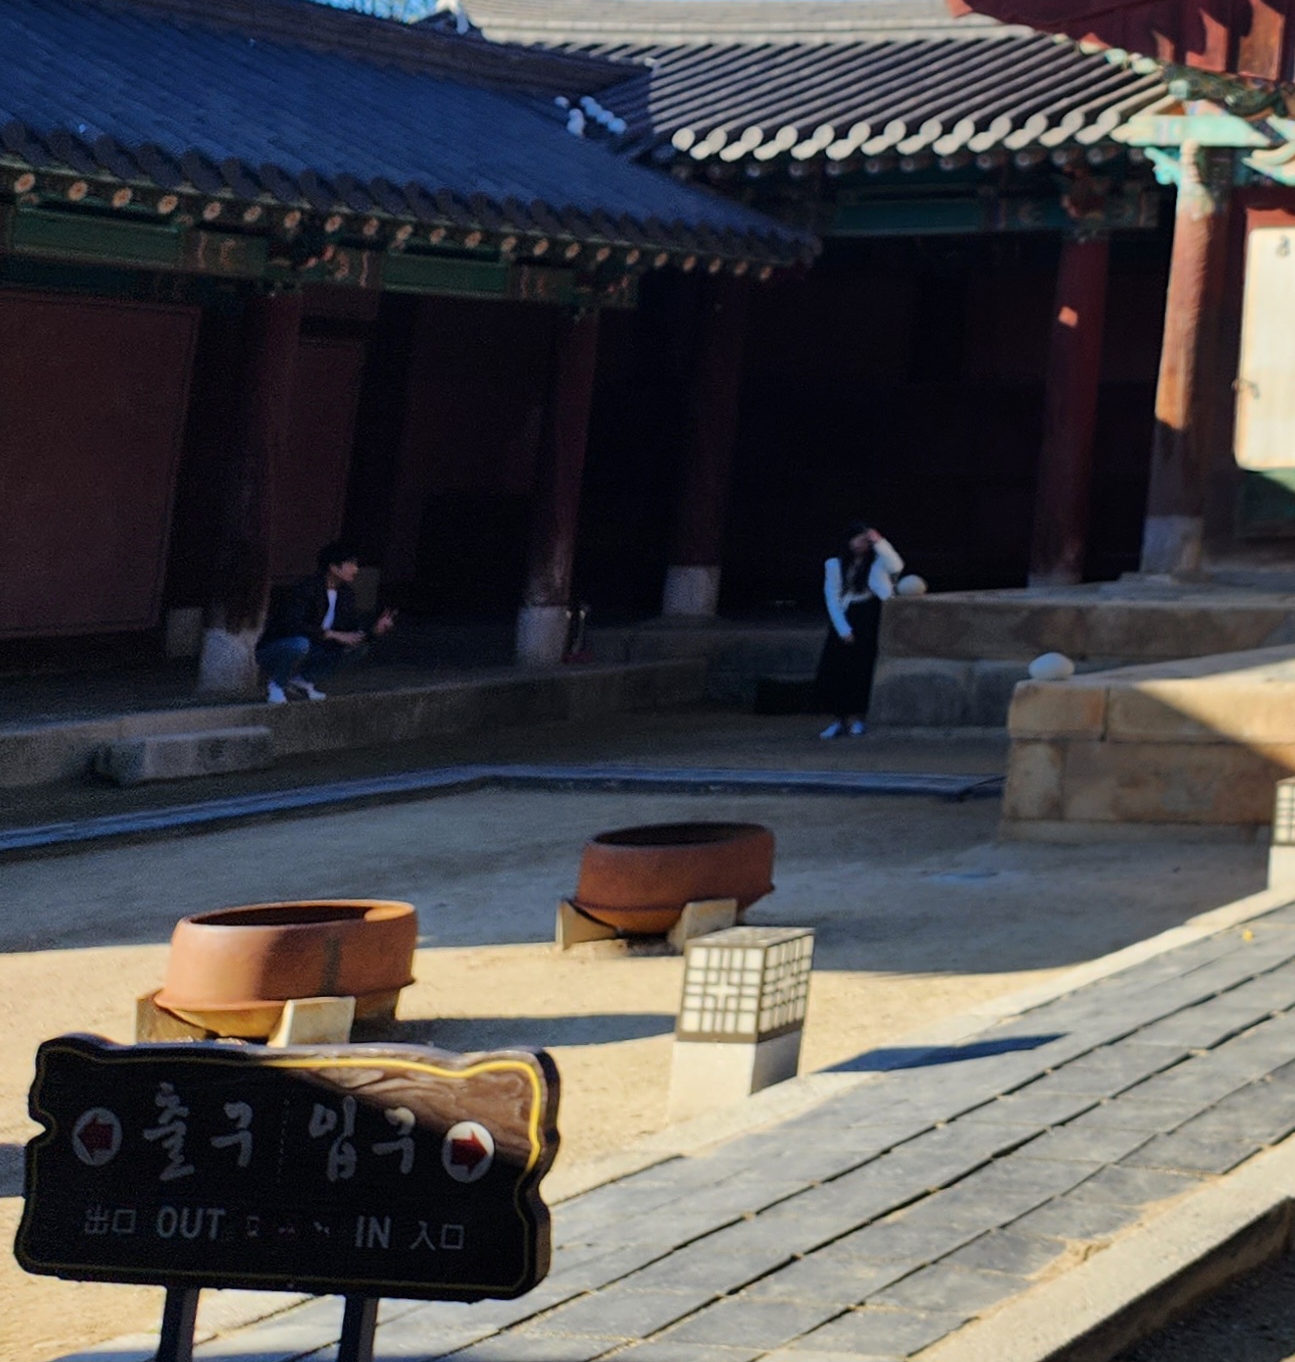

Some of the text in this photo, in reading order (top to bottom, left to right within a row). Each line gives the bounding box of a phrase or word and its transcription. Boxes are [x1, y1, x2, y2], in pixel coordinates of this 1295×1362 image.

[144, 1081, 254, 1181] 출구
[308, 1095, 416, 1183] 입구
[84, 1205, 137, 1235] 出口
[156, 1204, 226, 1240] OUT
[354, 1214, 392, 1249] IN
[408, 1219, 464, 1250] 入口
